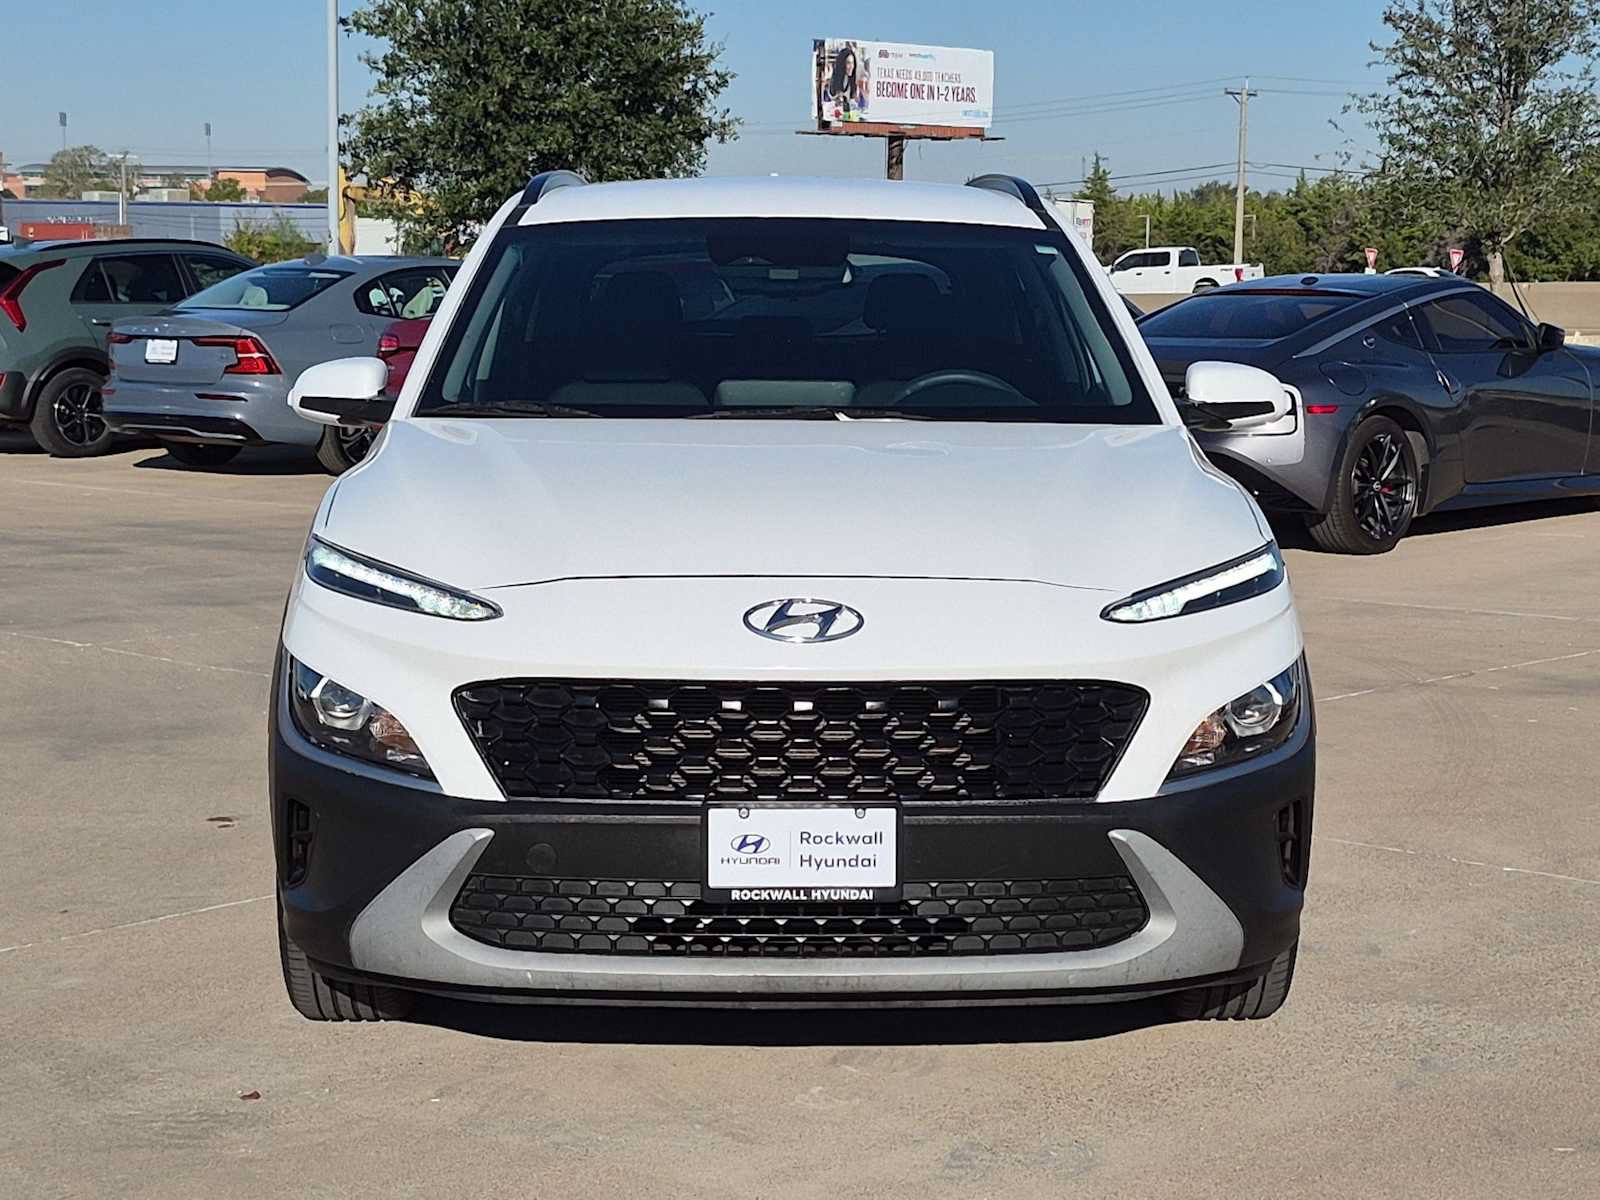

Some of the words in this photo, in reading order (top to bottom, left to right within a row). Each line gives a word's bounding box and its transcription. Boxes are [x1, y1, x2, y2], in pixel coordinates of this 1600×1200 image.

[877, 67, 894, 78] TEXAS
[896, 69, 912, 80] NEEDS
[876, 81, 908, 98] BECOME
[910, 83, 925, 100] ONE
[927, 85, 935, 100] IN
[936, 86, 949, 101] 1-2
[800, 831, 883, 845] Rockwall
[800, 854, 877, 871] Hyundai
[731, 889, 807, 901] ROCKWALL
[811, 889, 874, 900] HYUNDAI
